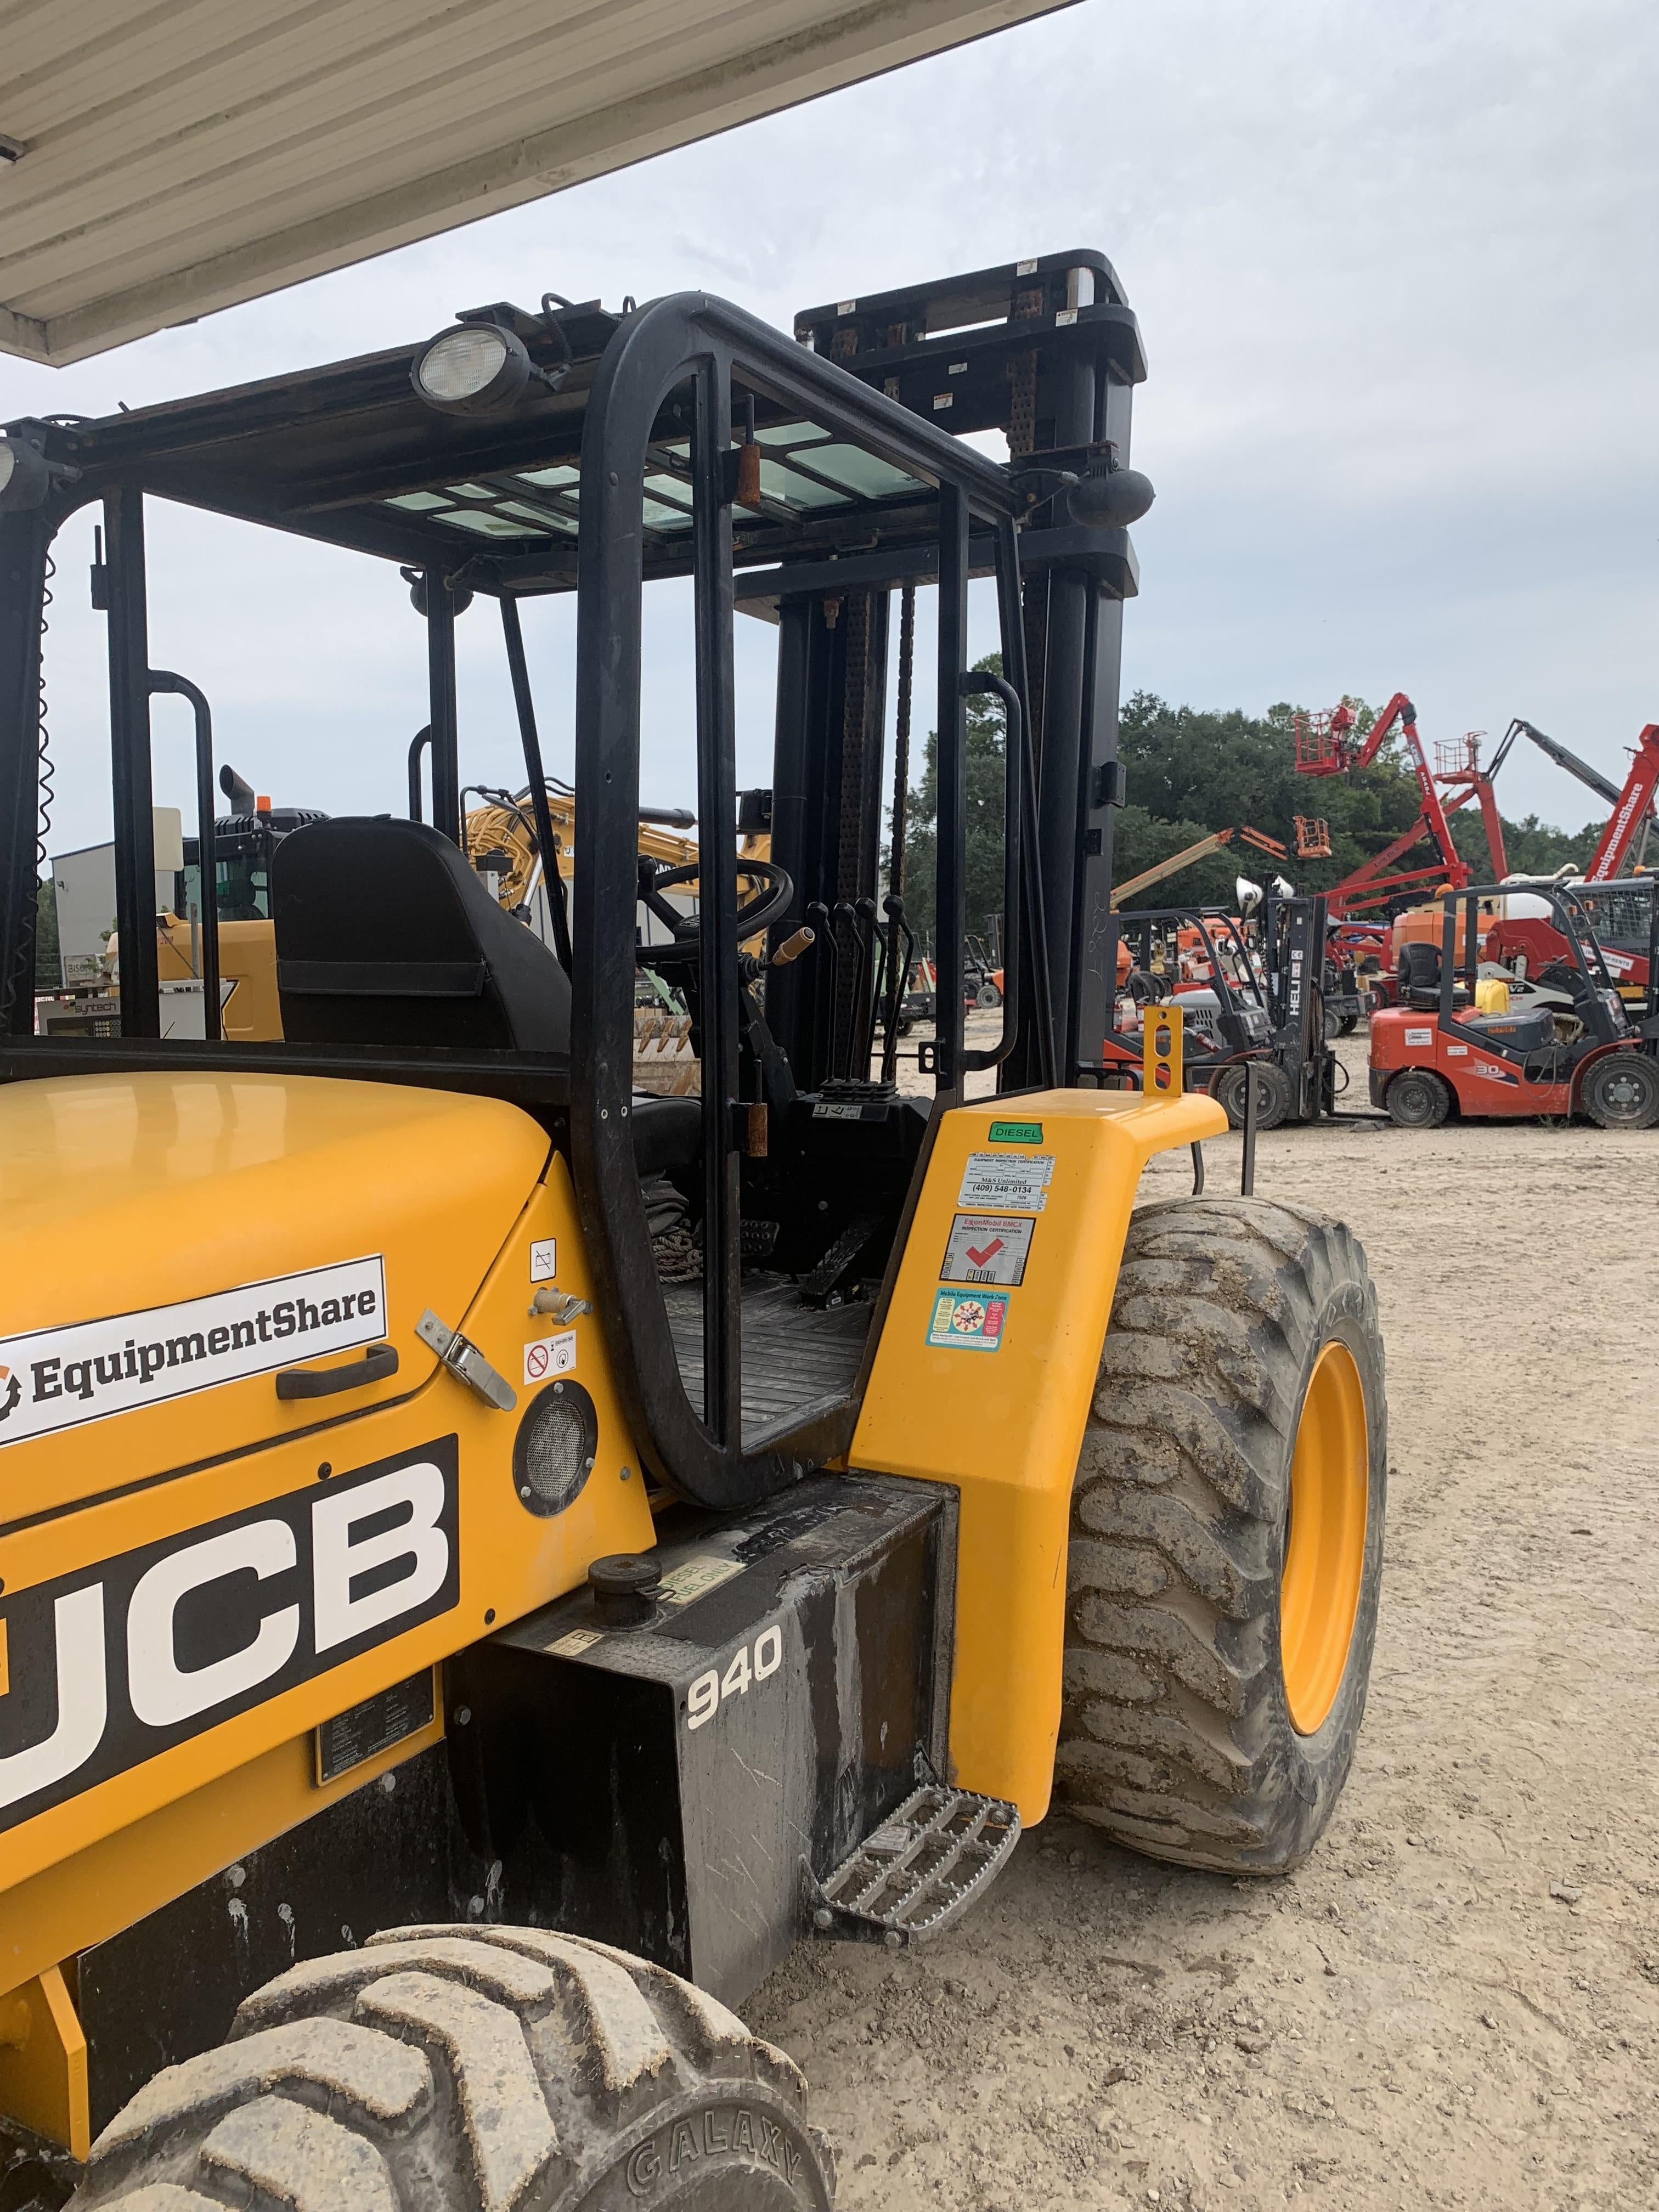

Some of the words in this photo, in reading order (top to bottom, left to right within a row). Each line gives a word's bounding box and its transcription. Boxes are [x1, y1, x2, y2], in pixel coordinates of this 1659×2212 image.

[1591, 783, 1643, 883] EquipmentShare
[75, 1002, 116, 1015] syntech
[1290, 980, 1300, 1015] HELI
[1476, 1065, 1499, 1075] 30
[996, 1128, 1037, 1137] DIESEL
[973, 1184, 992, 1192] (409)
[994, 1185, 1031, 1193] 548-0134
[964, 1218, 1001, 1227] ExxonMobil
[30, 1289, 376, 1402] EquipmentShare
[661, 1565, 706, 1589] DIESEL
[672, 1582, 706, 1600] FUEL
[700, 1562, 733, 1582] ONLY
[0, 1463, 449, 1808] JCB
[687, 1624, 782, 1730] 940
[627, 2110, 802, 2196] GALAXY
